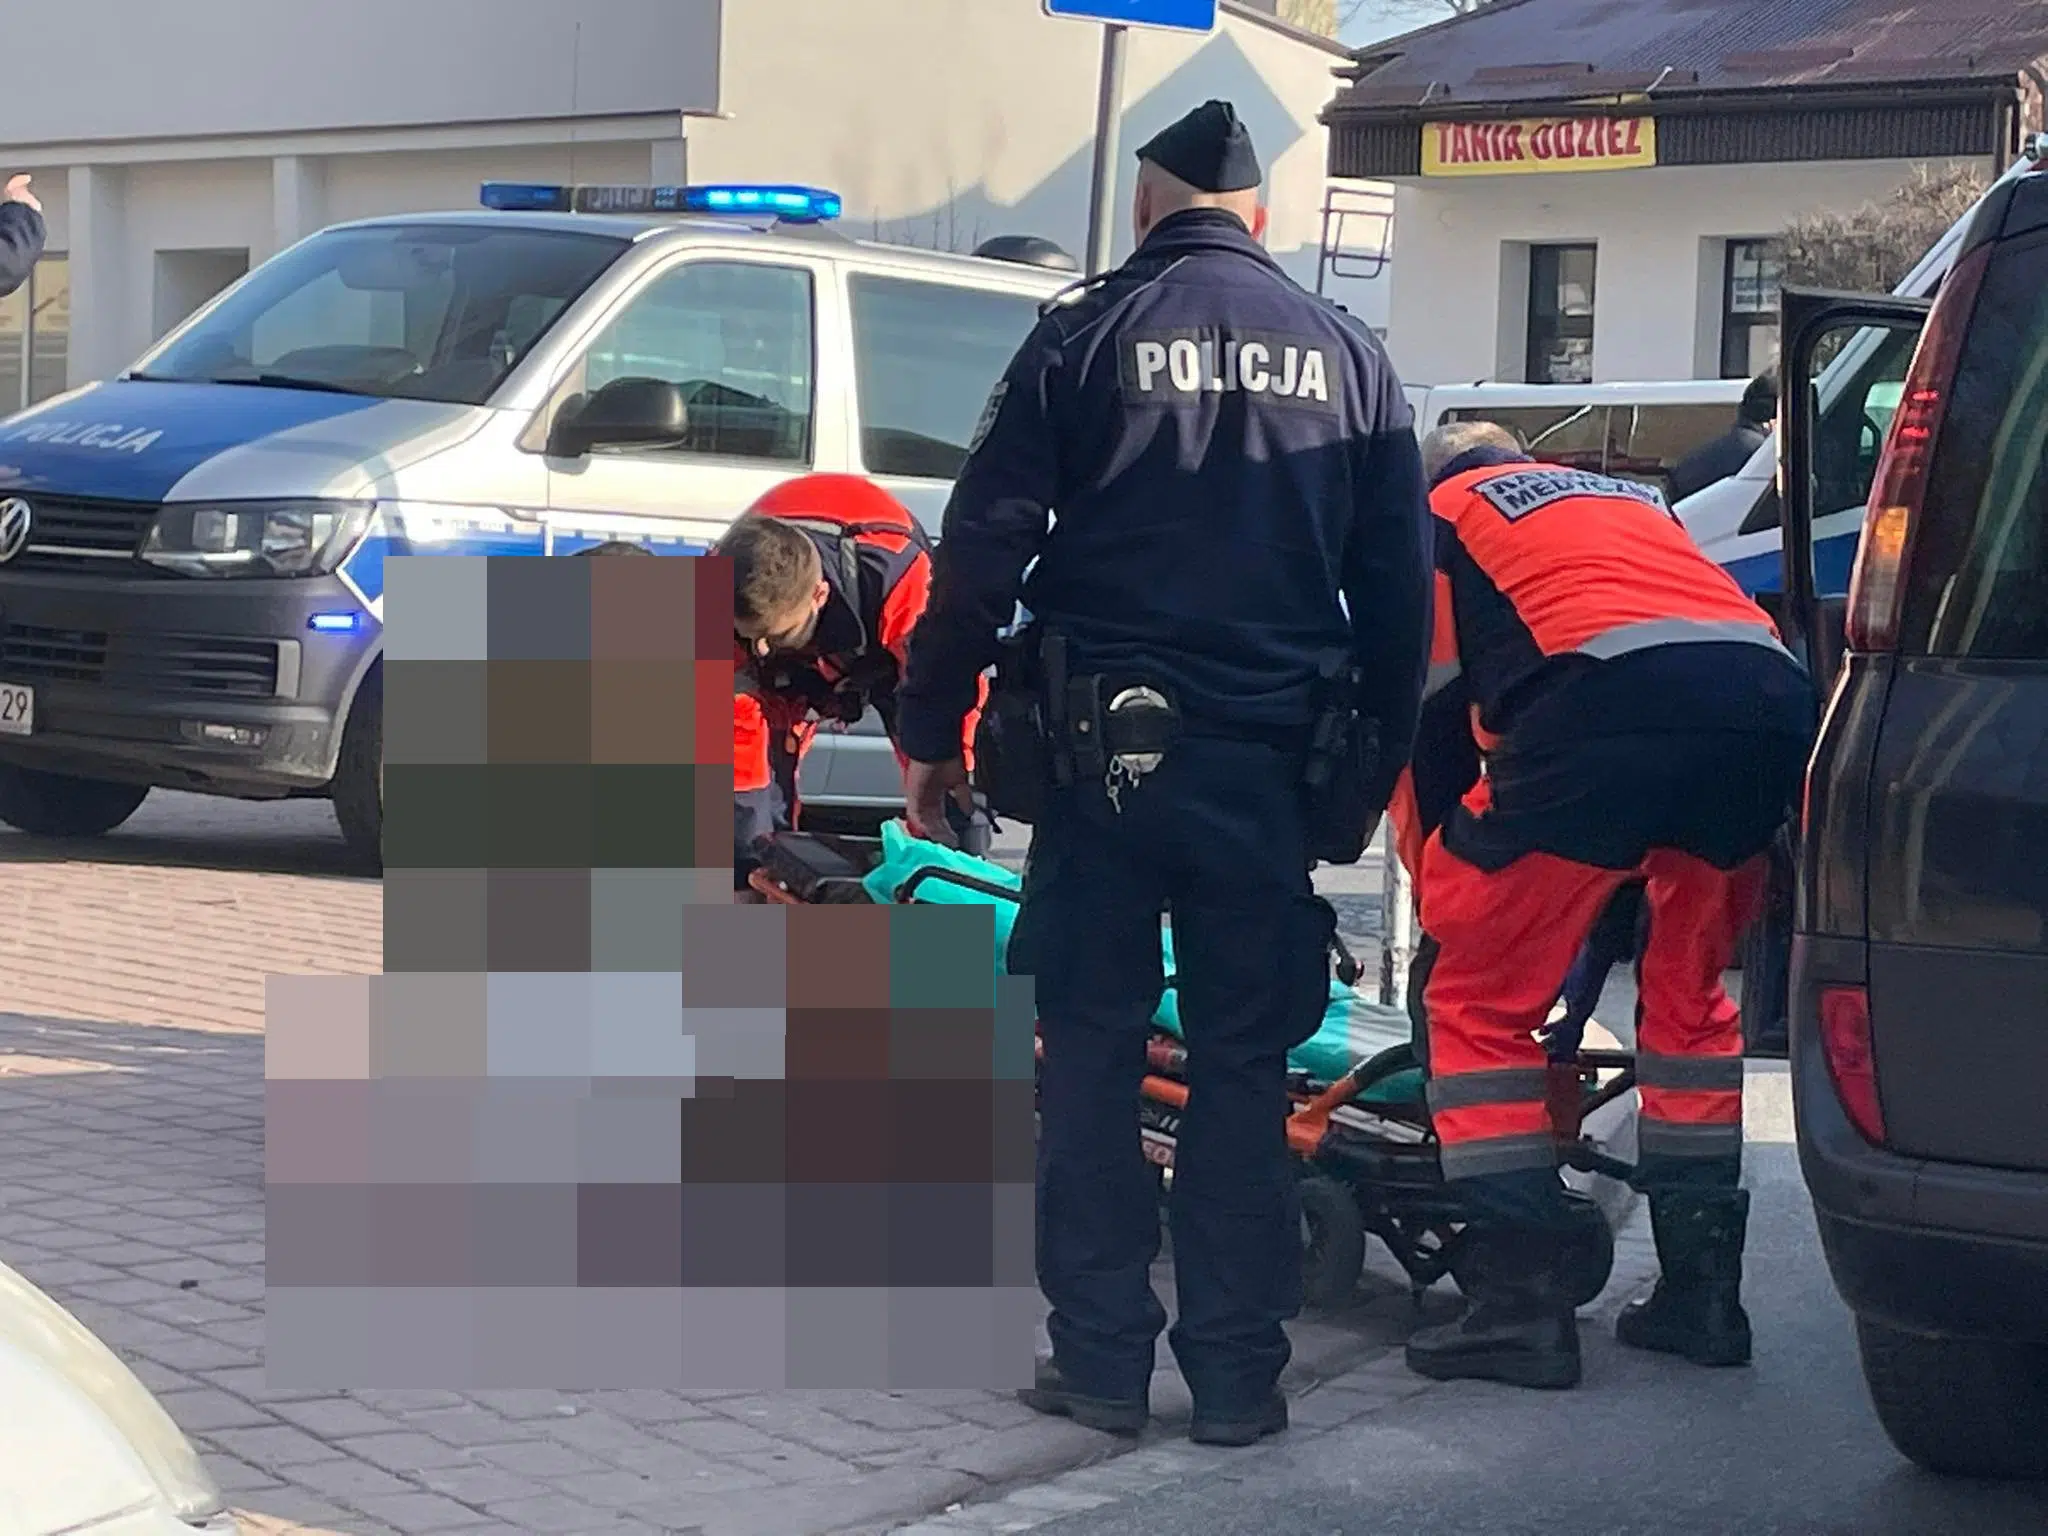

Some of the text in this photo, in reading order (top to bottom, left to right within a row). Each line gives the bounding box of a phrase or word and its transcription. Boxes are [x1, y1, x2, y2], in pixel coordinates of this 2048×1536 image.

[1435, 122, 1525, 163] TANIA
[1135, 339, 1328, 401] POLICJA
[3, 422, 164, 454] POLICJA
[2, 688, 28, 722] 29
